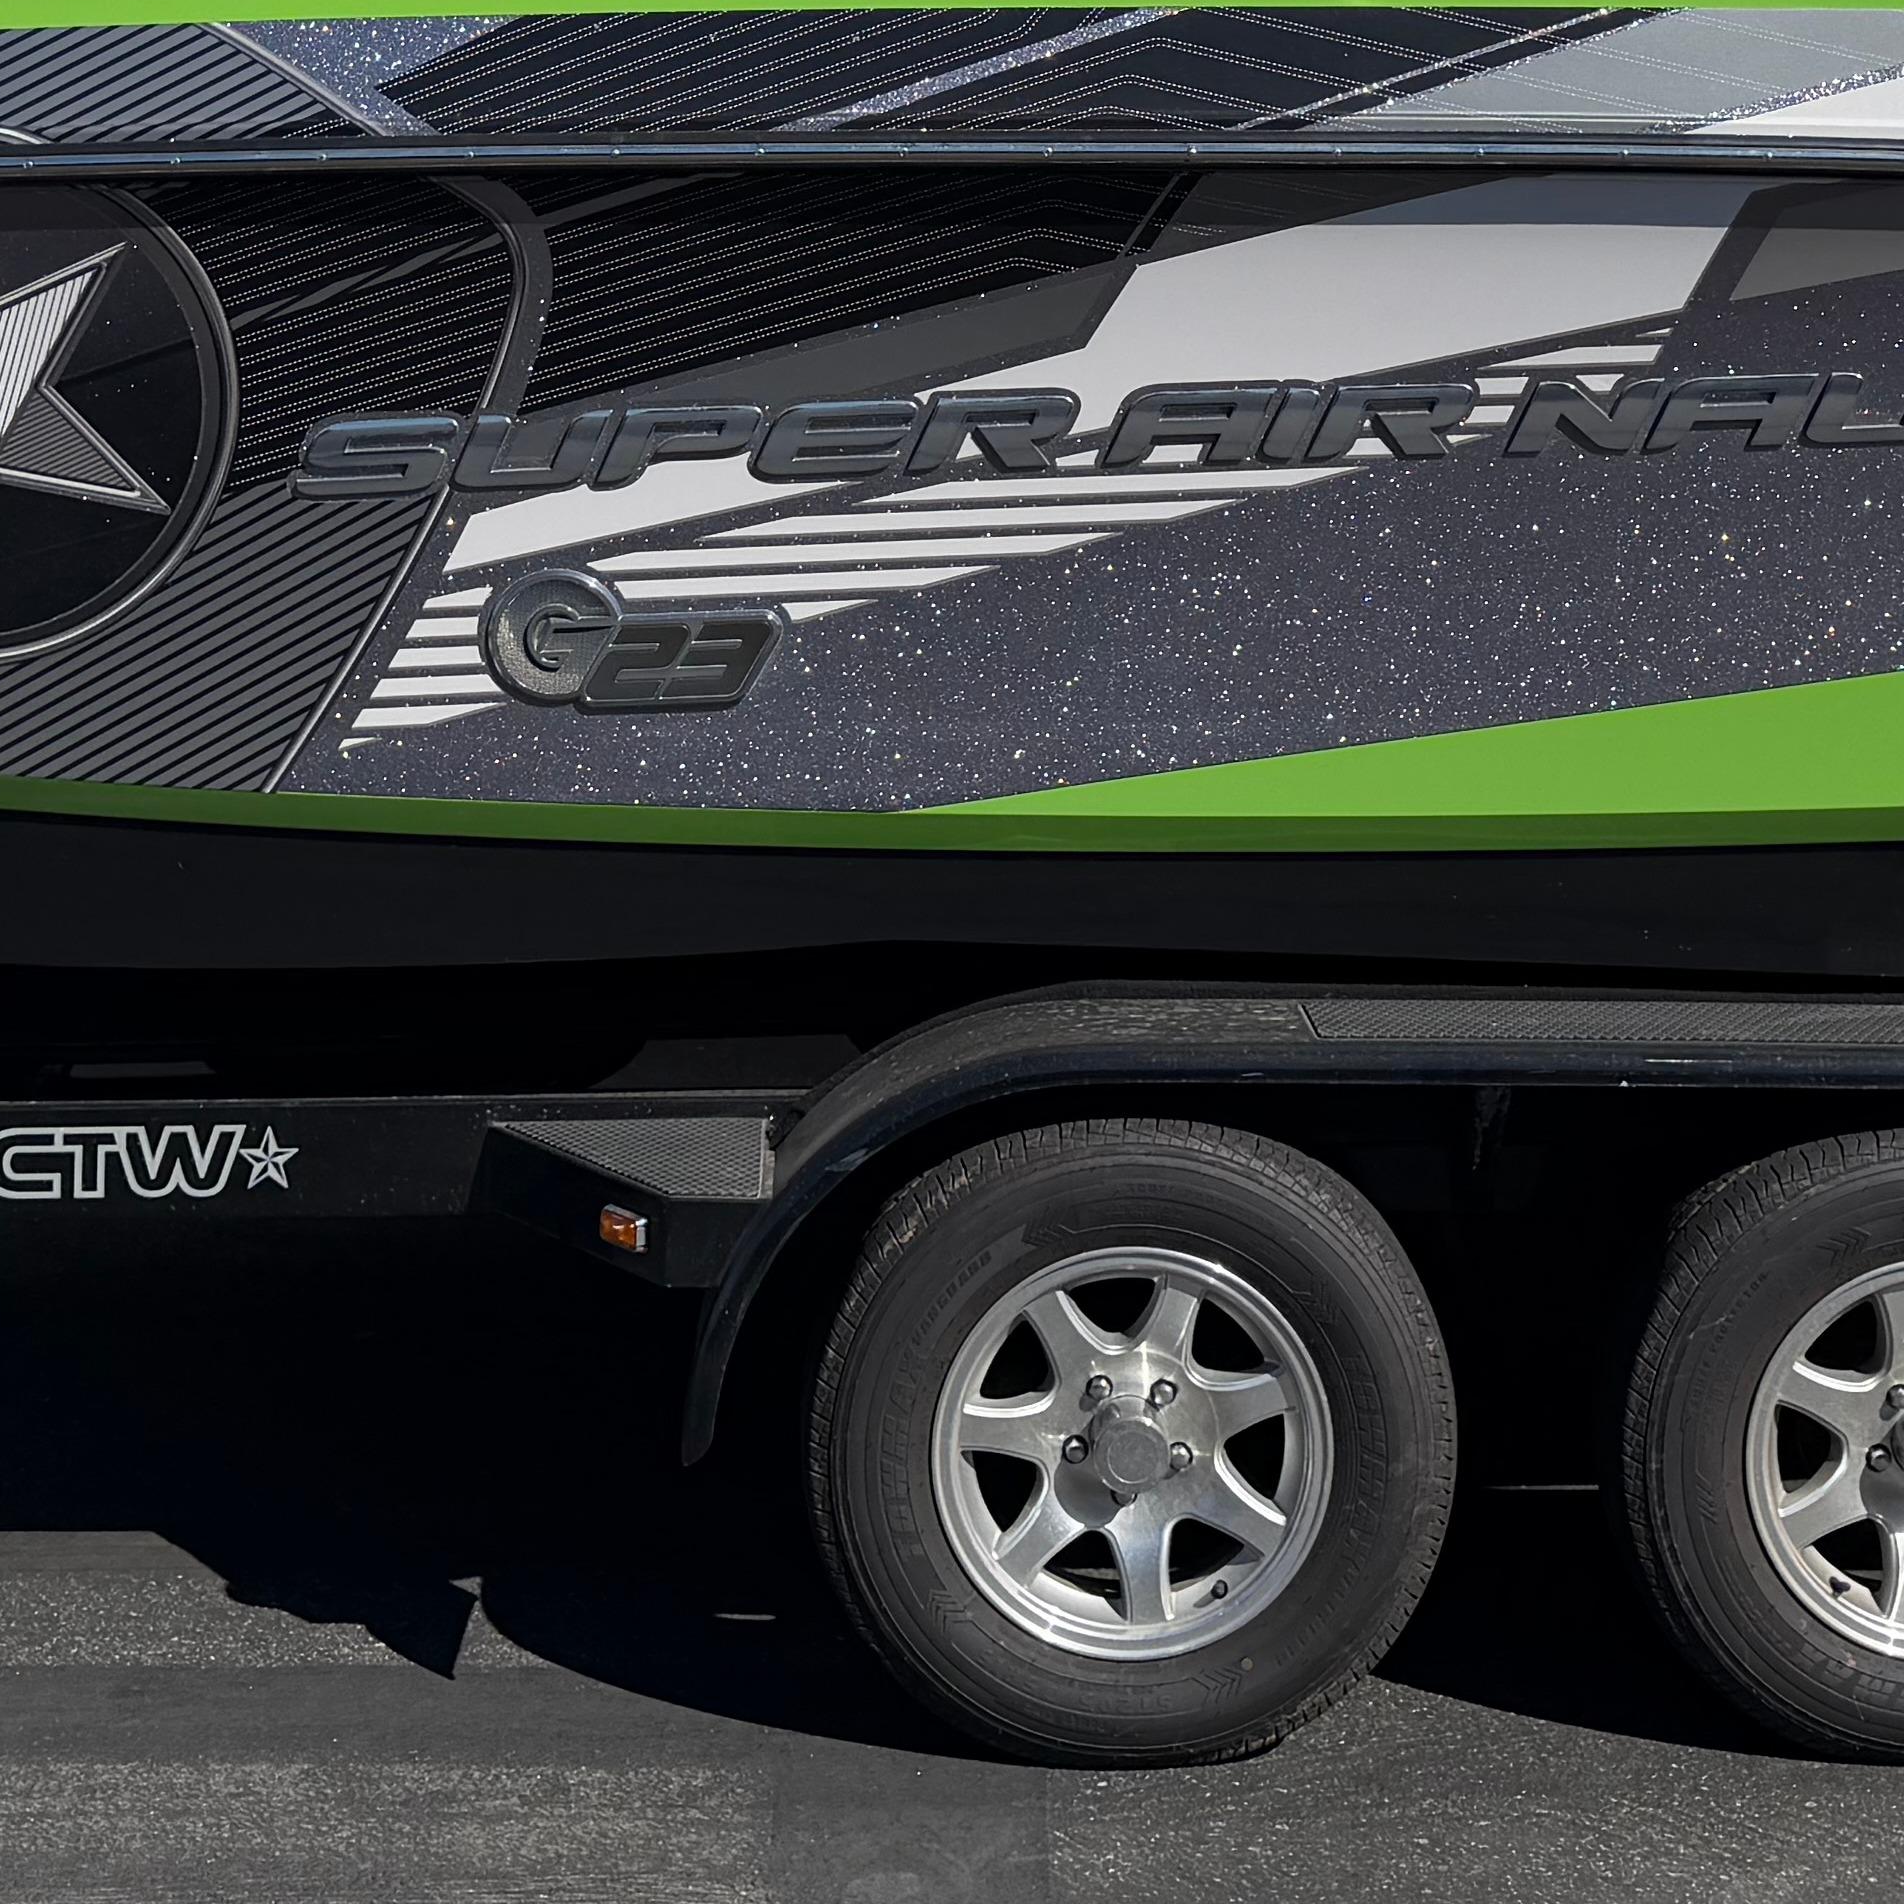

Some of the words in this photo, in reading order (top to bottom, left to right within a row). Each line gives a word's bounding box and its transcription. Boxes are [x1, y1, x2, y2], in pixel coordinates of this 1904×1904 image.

[293, 384, 1082, 495] SUPER
[1097, 378, 1478, 470] AIR
[484, 570, 786, 711] G23
